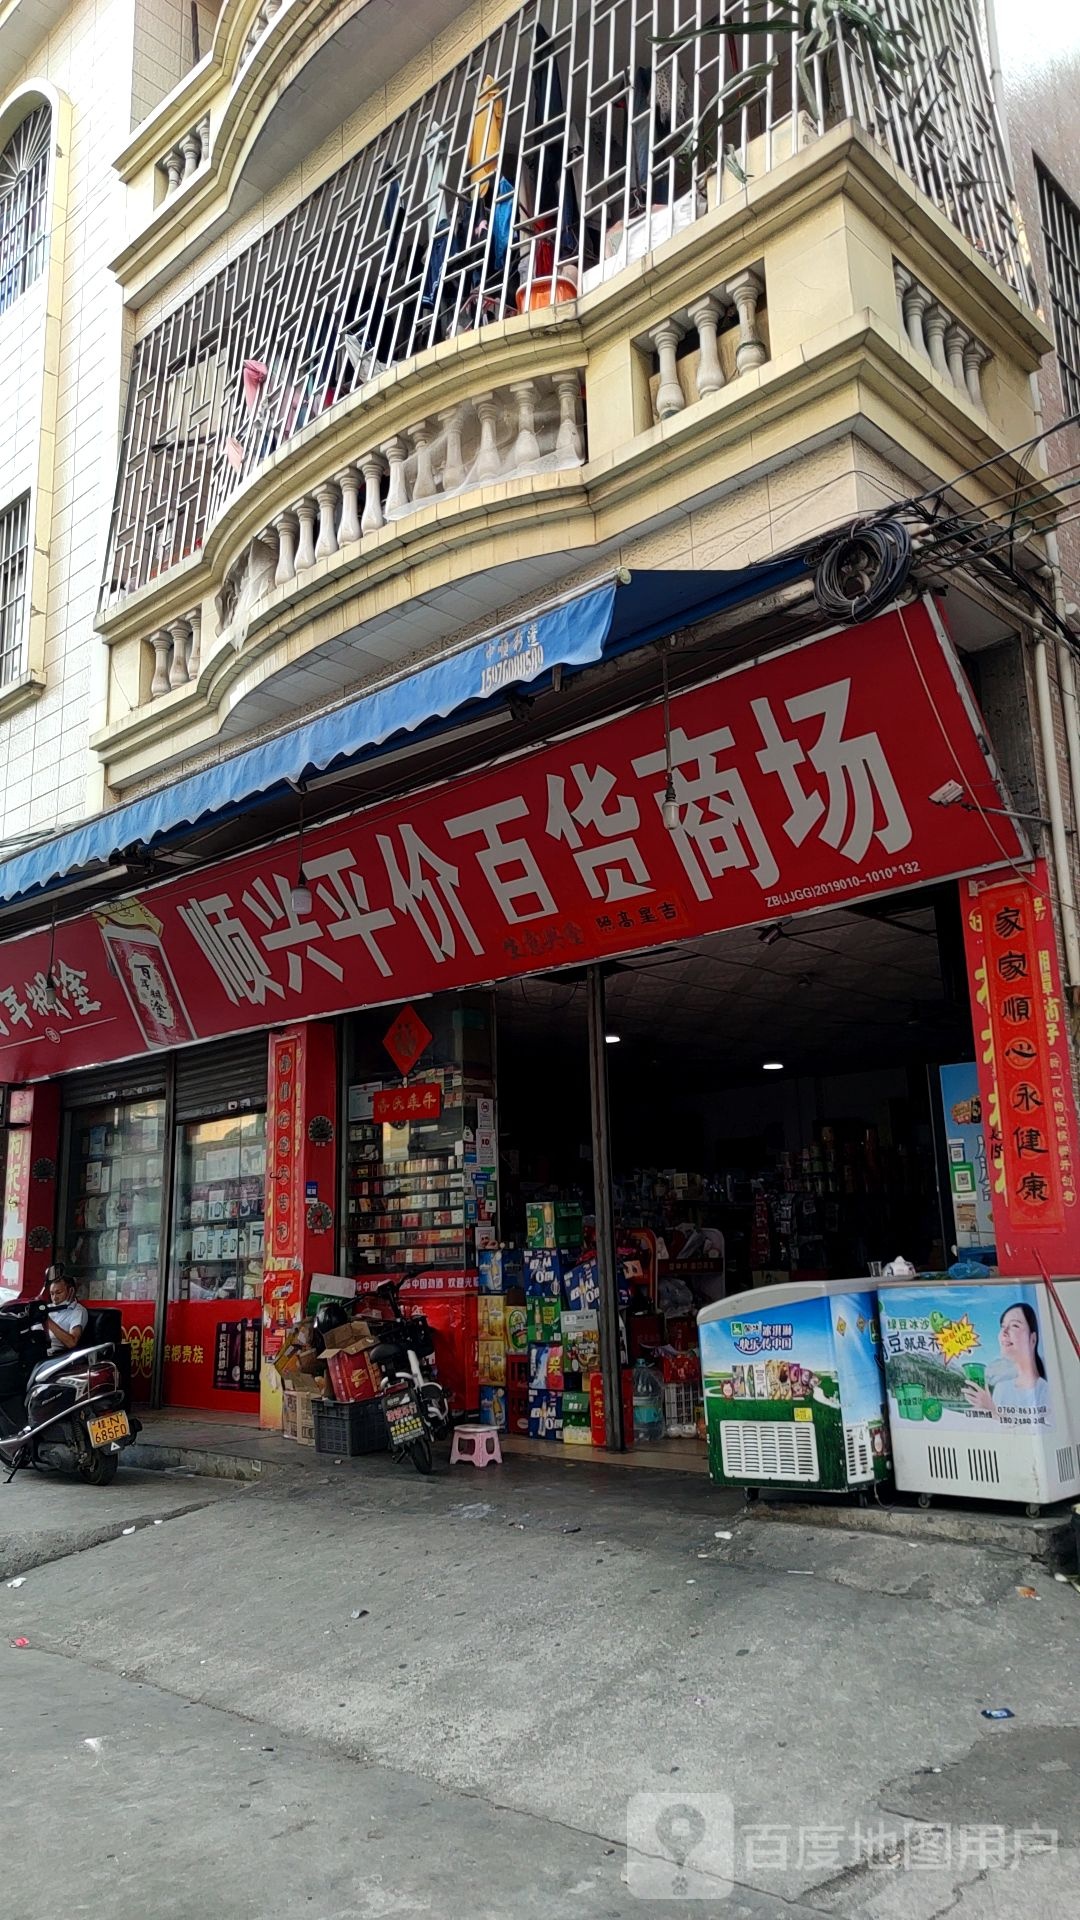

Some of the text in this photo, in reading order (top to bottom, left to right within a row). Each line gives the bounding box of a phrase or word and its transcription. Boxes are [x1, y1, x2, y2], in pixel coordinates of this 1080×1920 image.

[176, 677, 913, 1006] 顺兴平价百货商场
[95, 1423, 127, 1443] 685F0
